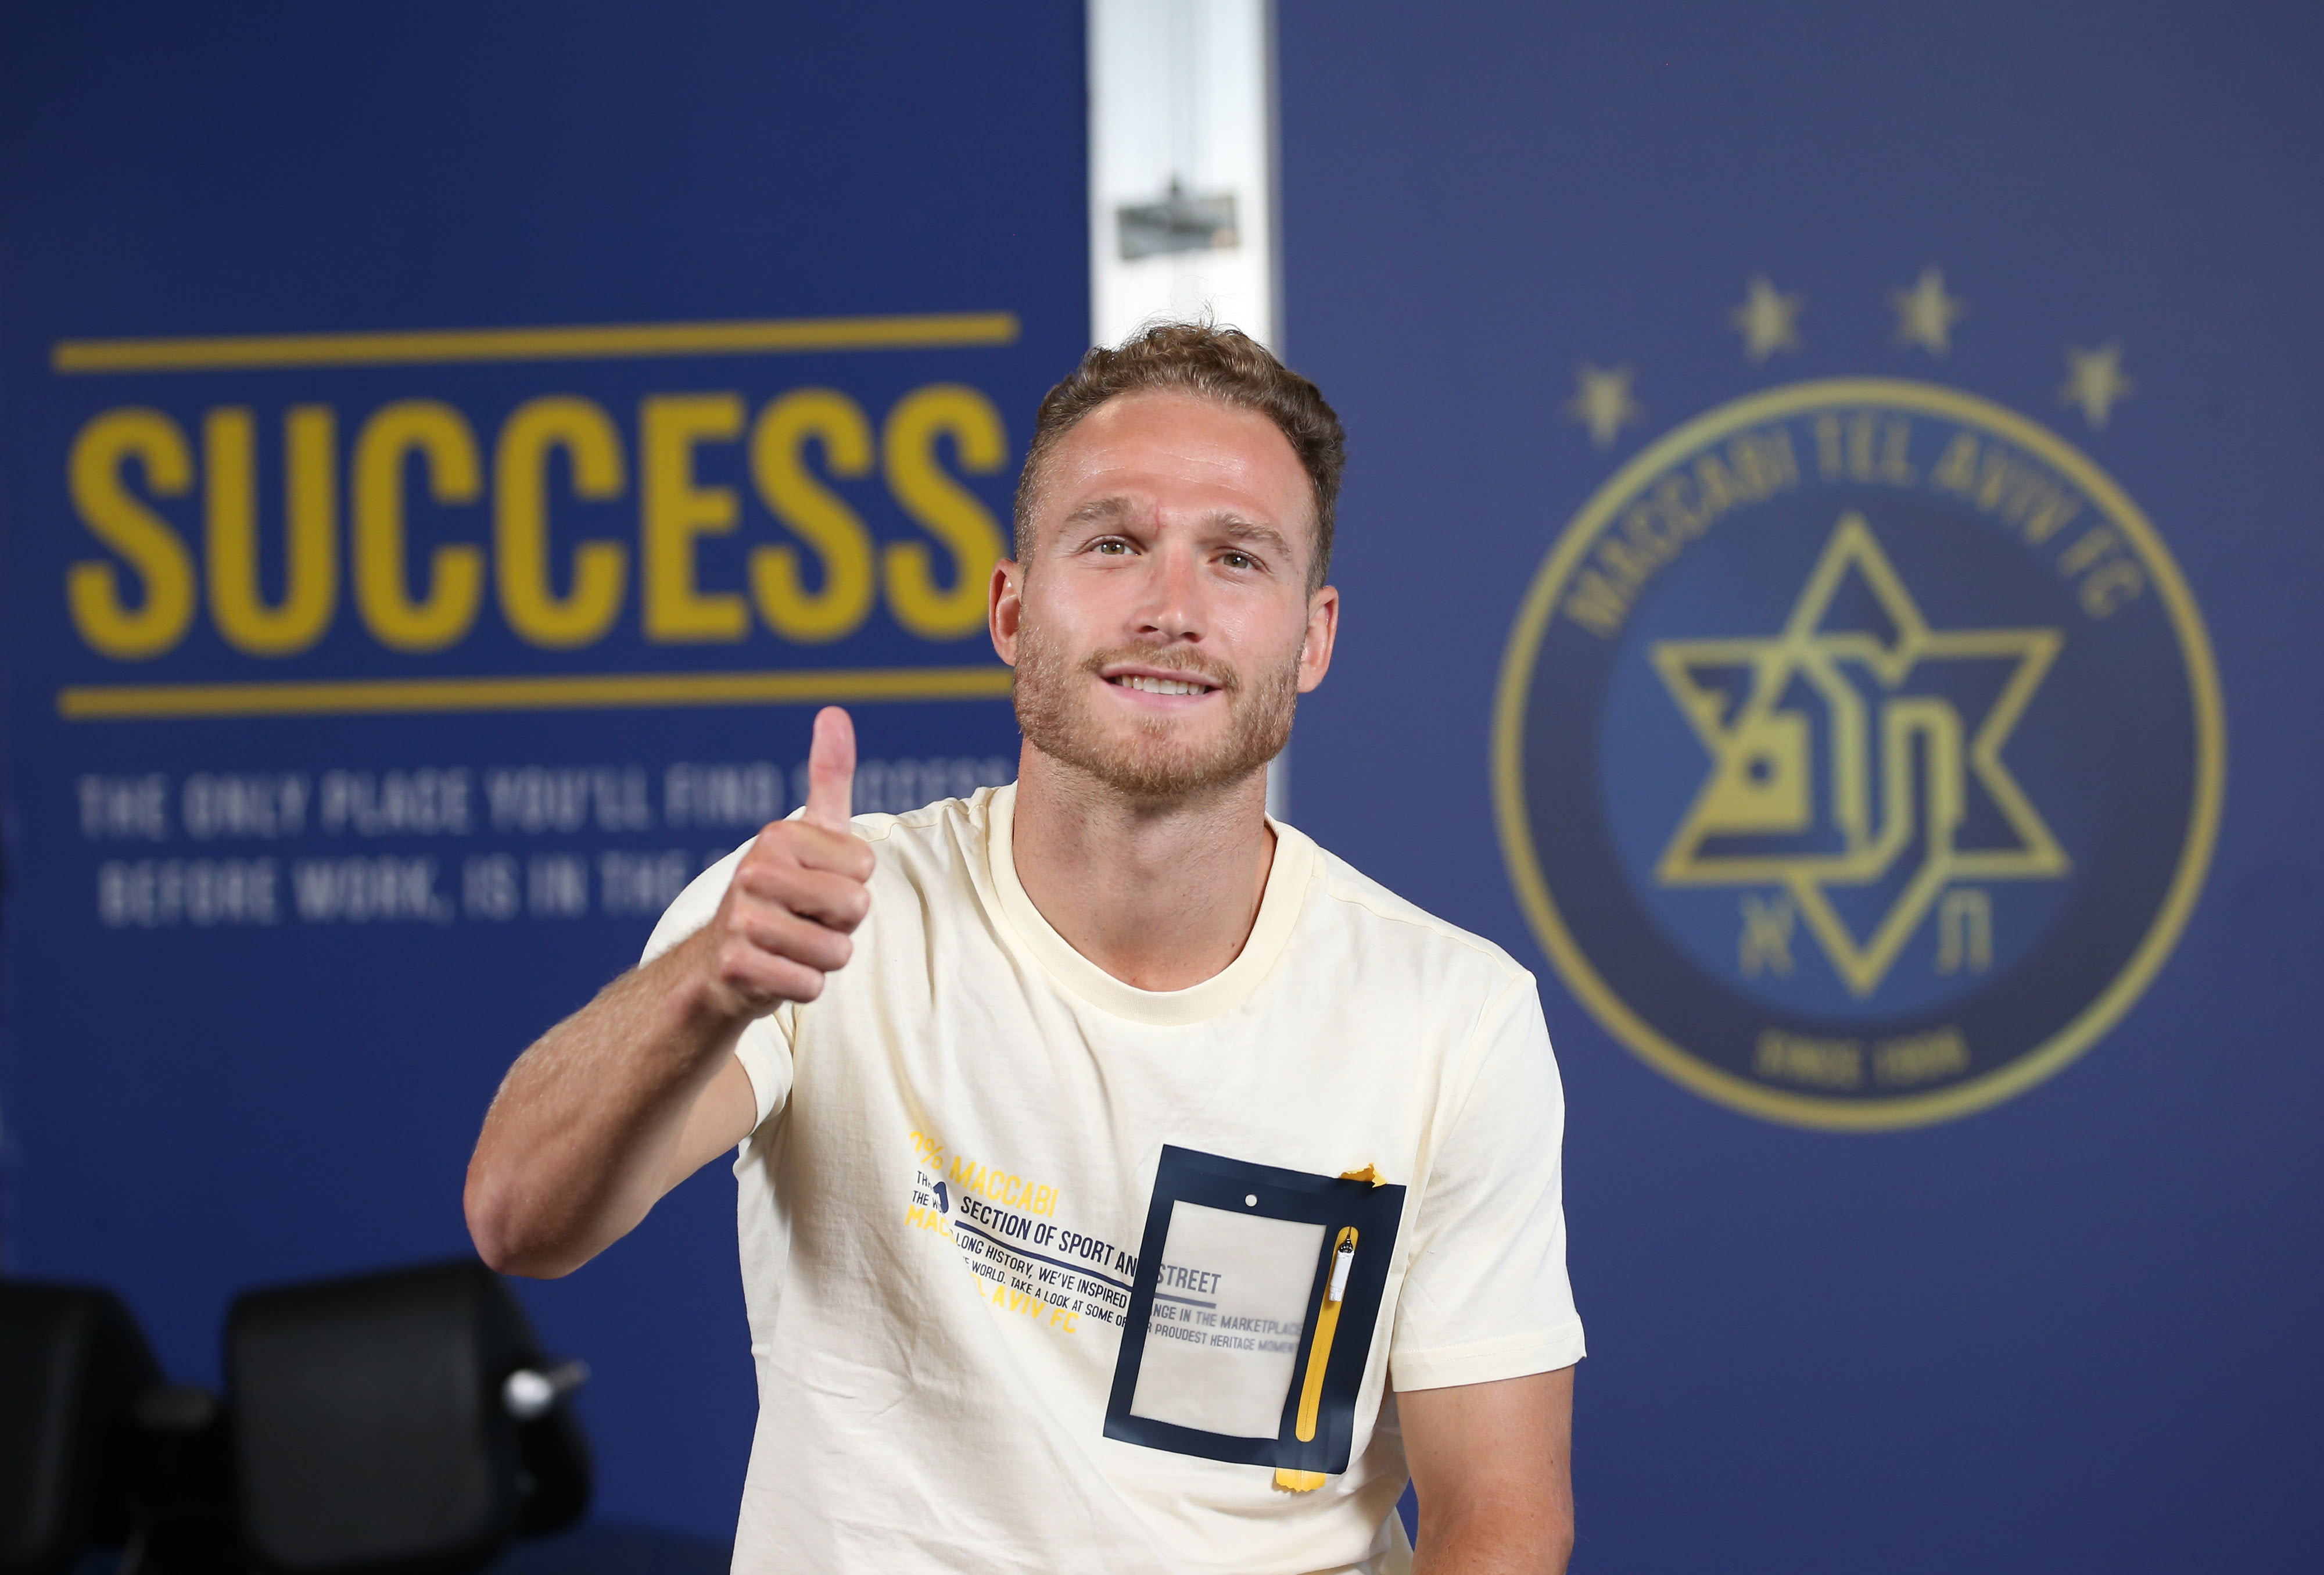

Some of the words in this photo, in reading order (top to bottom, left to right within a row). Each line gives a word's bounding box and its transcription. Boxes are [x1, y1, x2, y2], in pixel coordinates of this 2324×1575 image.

[66, 384, 1008, 661] SUCCESS
[1563, 425, 1799, 639] MACCABI
[1814, 410, 1913, 491] TEL
[1930, 431, 2083, 547] AVIV
[2056, 526, 2145, 620] FC
[80, 773, 167, 841] THE
[183, 770, 309, 841] ONLY
[320, 766, 470, 837] PLACE
[664, 760, 786, 828] FIND
[96, 857, 277, 928] BEFORE
[462, 853, 521, 922] IS
[527, 851, 587, 919] IN
[949, 1155, 1059, 1218] MACCABI
[912, 1190, 930, 1207] THE
[971, 1260, 1006, 1284] WORLD.
[1010, 1276, 1033, 1295] TAKE
[1034, 1287, 1042, 1299] A
[1043, 1290, 1071, 1309] LOOK
[1071, 1299, 1084, 1313] AT
[1085, 1303, 1114, 1323] SOME
[1154, 1323, 1208, 1345] PROUDEST
[1210, 1334, 1256, 1351] HERITAGE
[956, 1232, 984, 1255] LONG
[985, 1245, 1034, 1279] HISTORY,
[1038, 1266, 1075, 1290] WE'VE
[1077, 1279, 1128, 1309] INSPIRED
[1151, 1303, 1177, 1320] NGE
[1179, 1308, 1192, 1323] IN
[1196, 1311, 1217, 1327] THE
[960, 1195, 1032, 1241] SECTION
[1034, 1223, 1057, 1246] OF
[1058, 1230, 1115, 1266] SPORT
[1114, 1251, 1138, 1277] AN
[1157, 1263, 1222, 1294] STREET
[991, 1284, 1046, 1319] AVIV
[1049, 1308, 1080, 1334] FC
